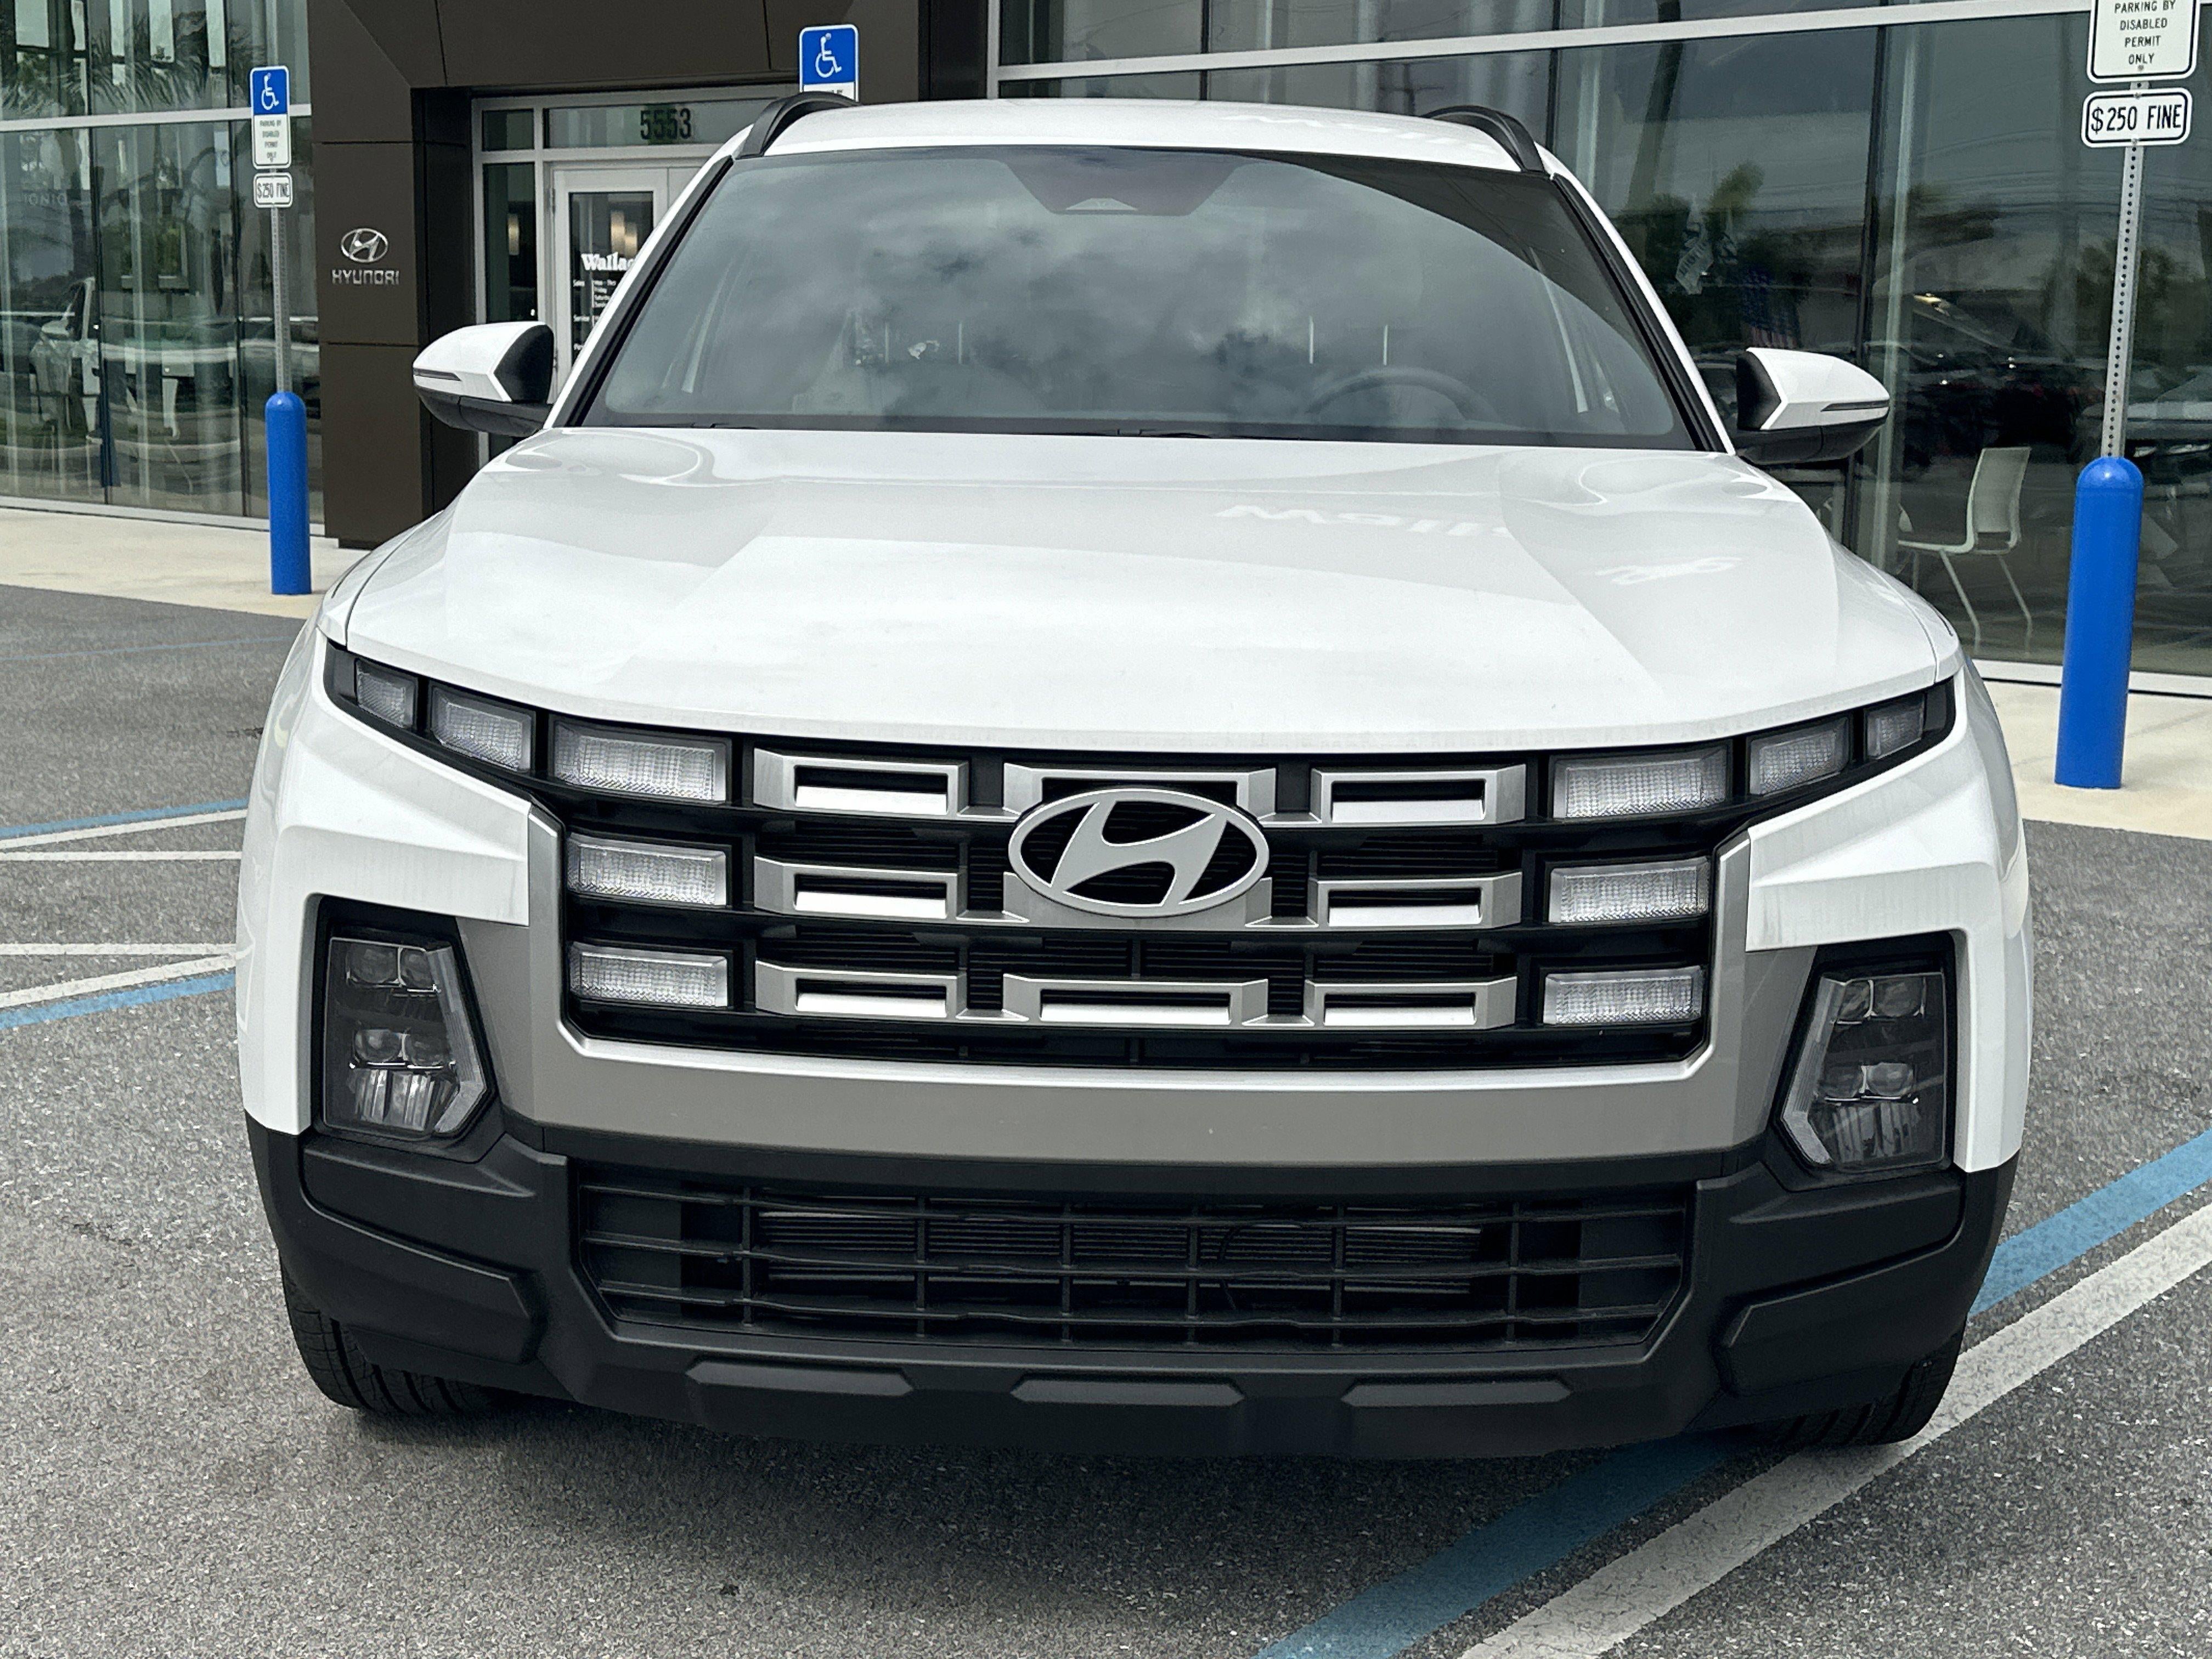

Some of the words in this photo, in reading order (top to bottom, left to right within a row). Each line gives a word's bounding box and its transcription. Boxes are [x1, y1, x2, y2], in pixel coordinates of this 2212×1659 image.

[2114, 1, 2158, 14] PARKING
[2163, 0, 2176, 10] BY
[2120, 17, 2168, 31] DISABLED
[2124, 35, 2162, 48] PERMIT
[2129, 53, 2155, 65] ONLY
[640, 108, 691, 140] 5553
[2091, 106, 2138, 135] $250
[2147, 104, 2182, 129] FINE
[332, 269, 399, 285] HYUNDAI
